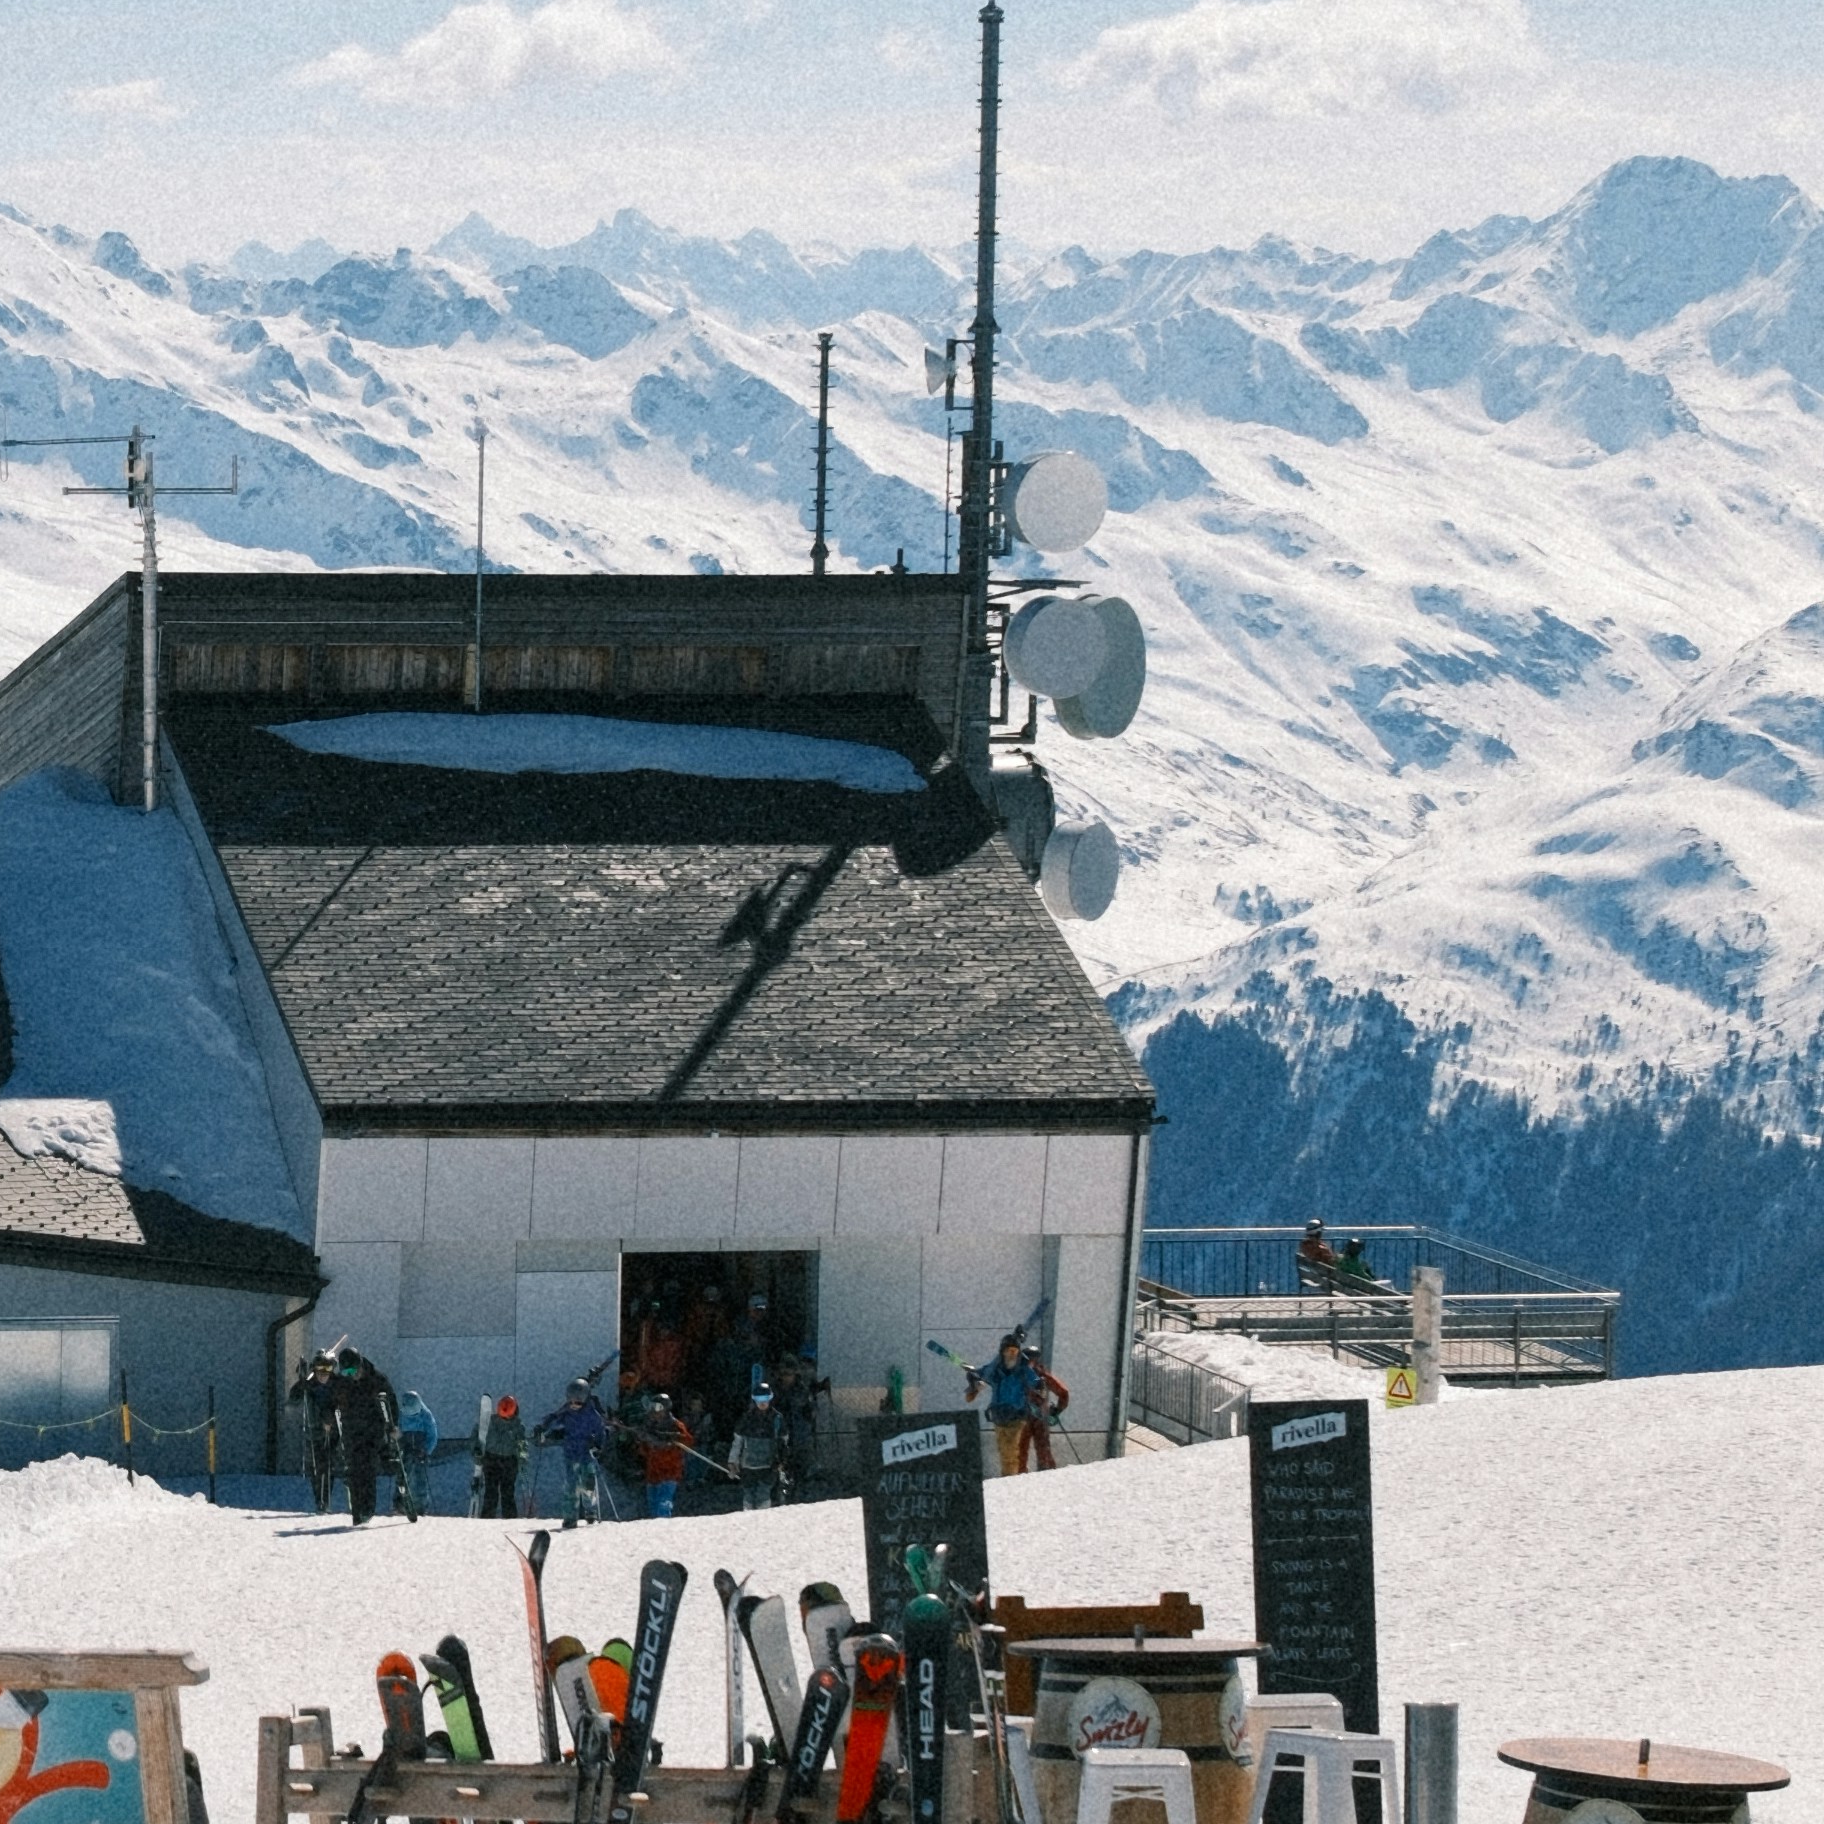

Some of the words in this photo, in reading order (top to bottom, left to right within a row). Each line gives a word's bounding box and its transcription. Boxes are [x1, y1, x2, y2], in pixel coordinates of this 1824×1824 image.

[892, 1431, 948, 1458] rivella
[1281, 1418, 1337, 1443] rivella
[631, 1578, 668, 1724] STÖCKLI
[919, 1658, 934, 1760] HEAD
